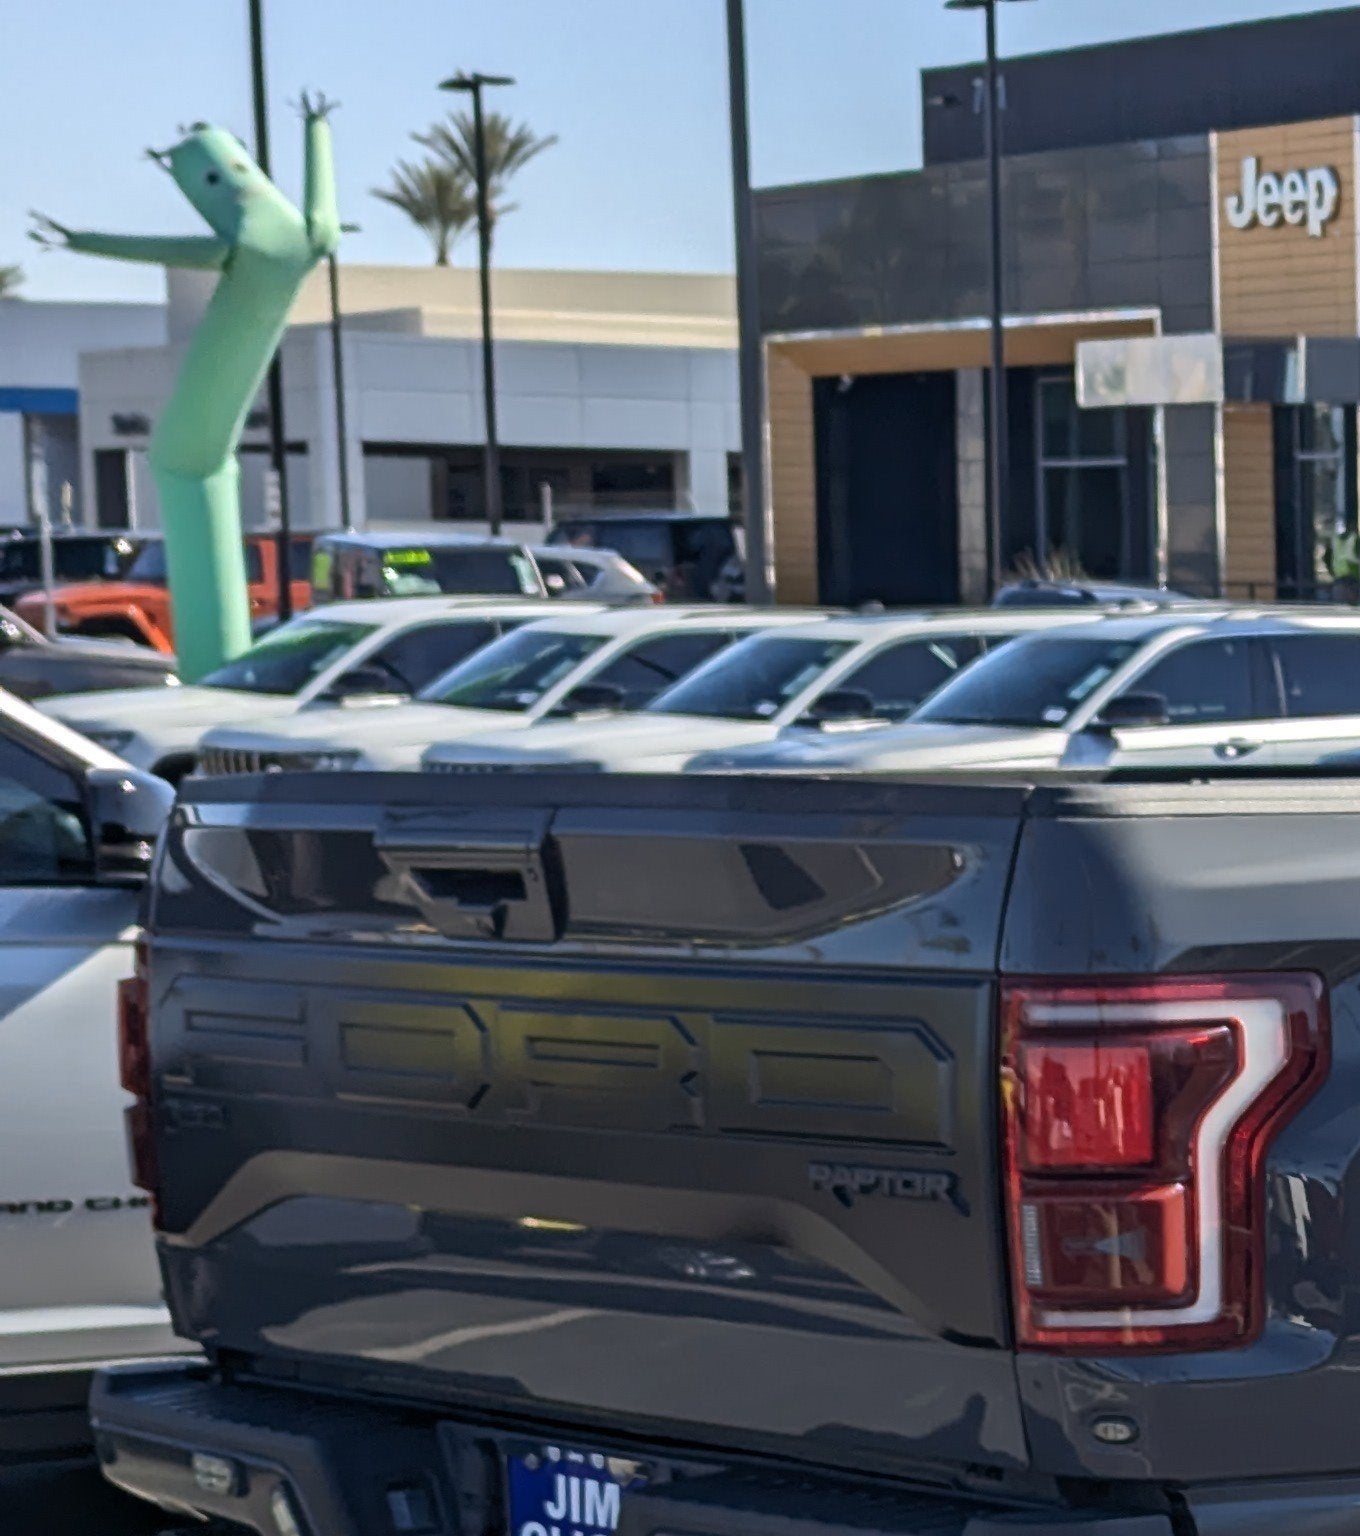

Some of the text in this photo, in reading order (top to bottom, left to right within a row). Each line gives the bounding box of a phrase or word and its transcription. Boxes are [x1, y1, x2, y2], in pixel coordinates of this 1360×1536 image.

[1225, 156, 1338, 238] Jeep
[158, 972, 958, 1154] FORD
[808, 1160, 965, 1210] RAPTOR
[545, 1473, 620, 1529] JIM
